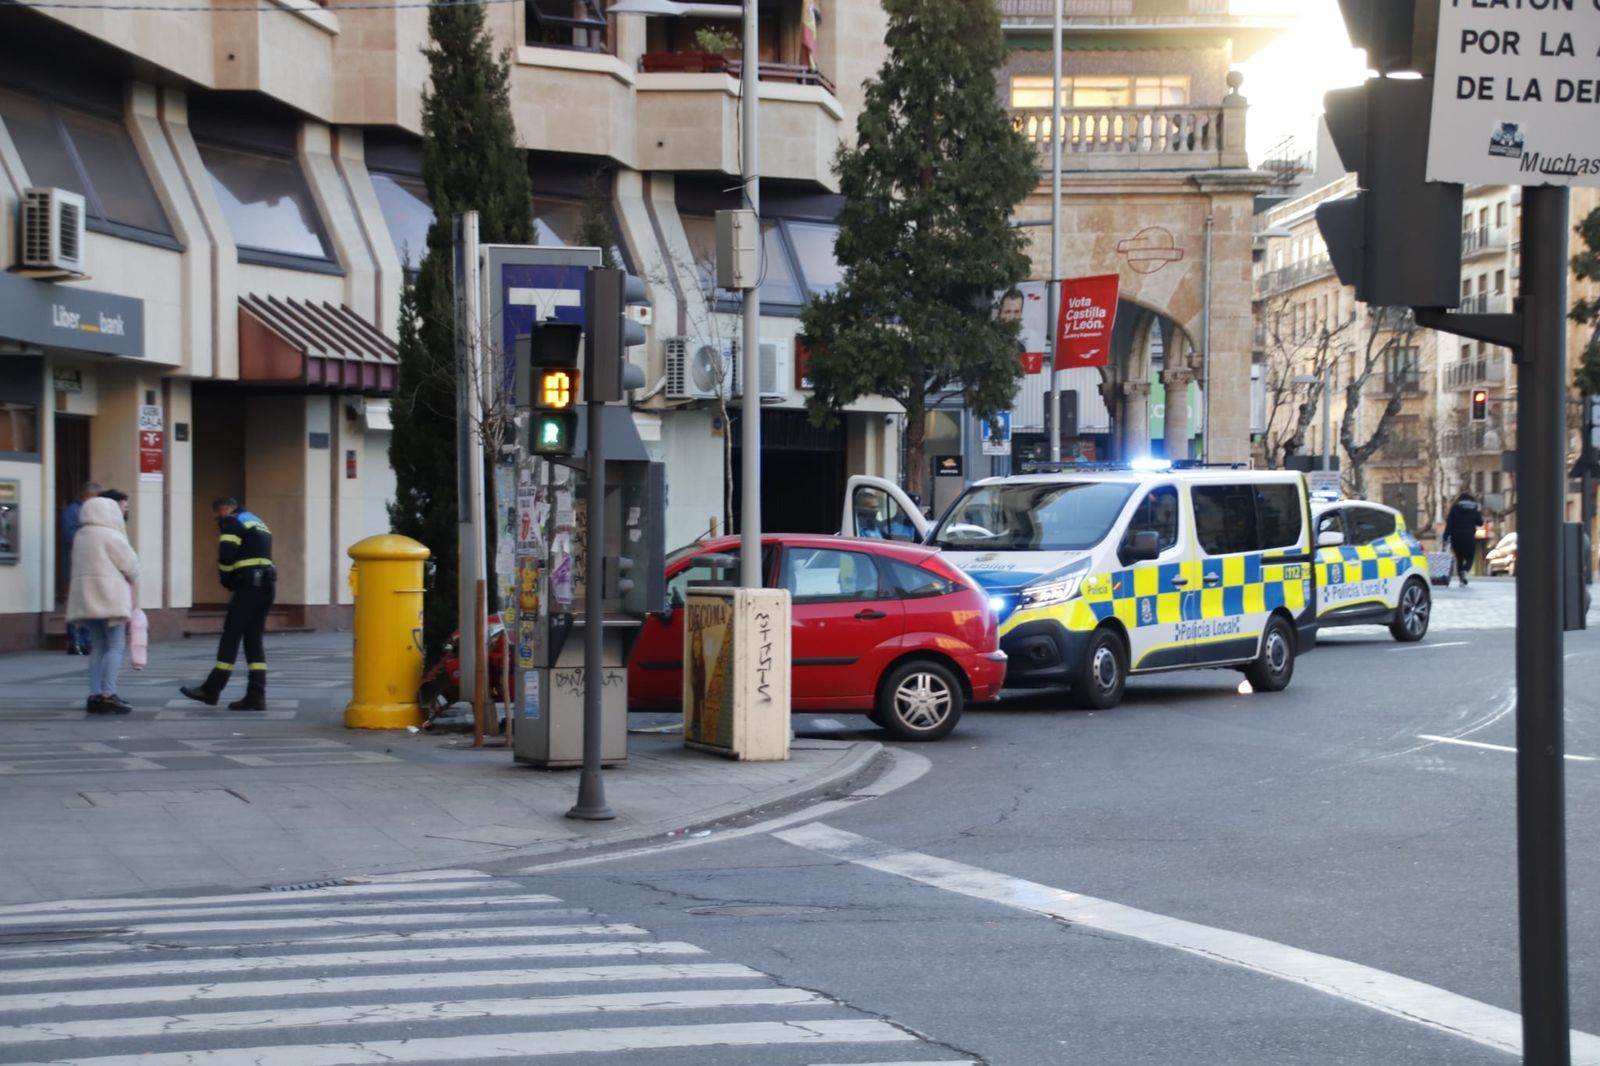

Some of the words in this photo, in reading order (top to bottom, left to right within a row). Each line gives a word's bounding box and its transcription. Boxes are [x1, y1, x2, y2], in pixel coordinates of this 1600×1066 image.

[1460, 29, 1520, 55] POR
[1540, 31, 1576, 57] LA
[1456, 75, 1495, 101] DE
[1506, 77, 1542, 102] LA
[1519, 151, 1600, 176] Muchas
[1066, 306, 1107, 321] Castilla
[1069, 297, 1092, 309] Vota
[1064, 322, 1072, 335] y
[1073, 318, 1105, 331] León.
[1180, 620, 1211, 641] Policía
[1212, 616, 1236, 637] Local
